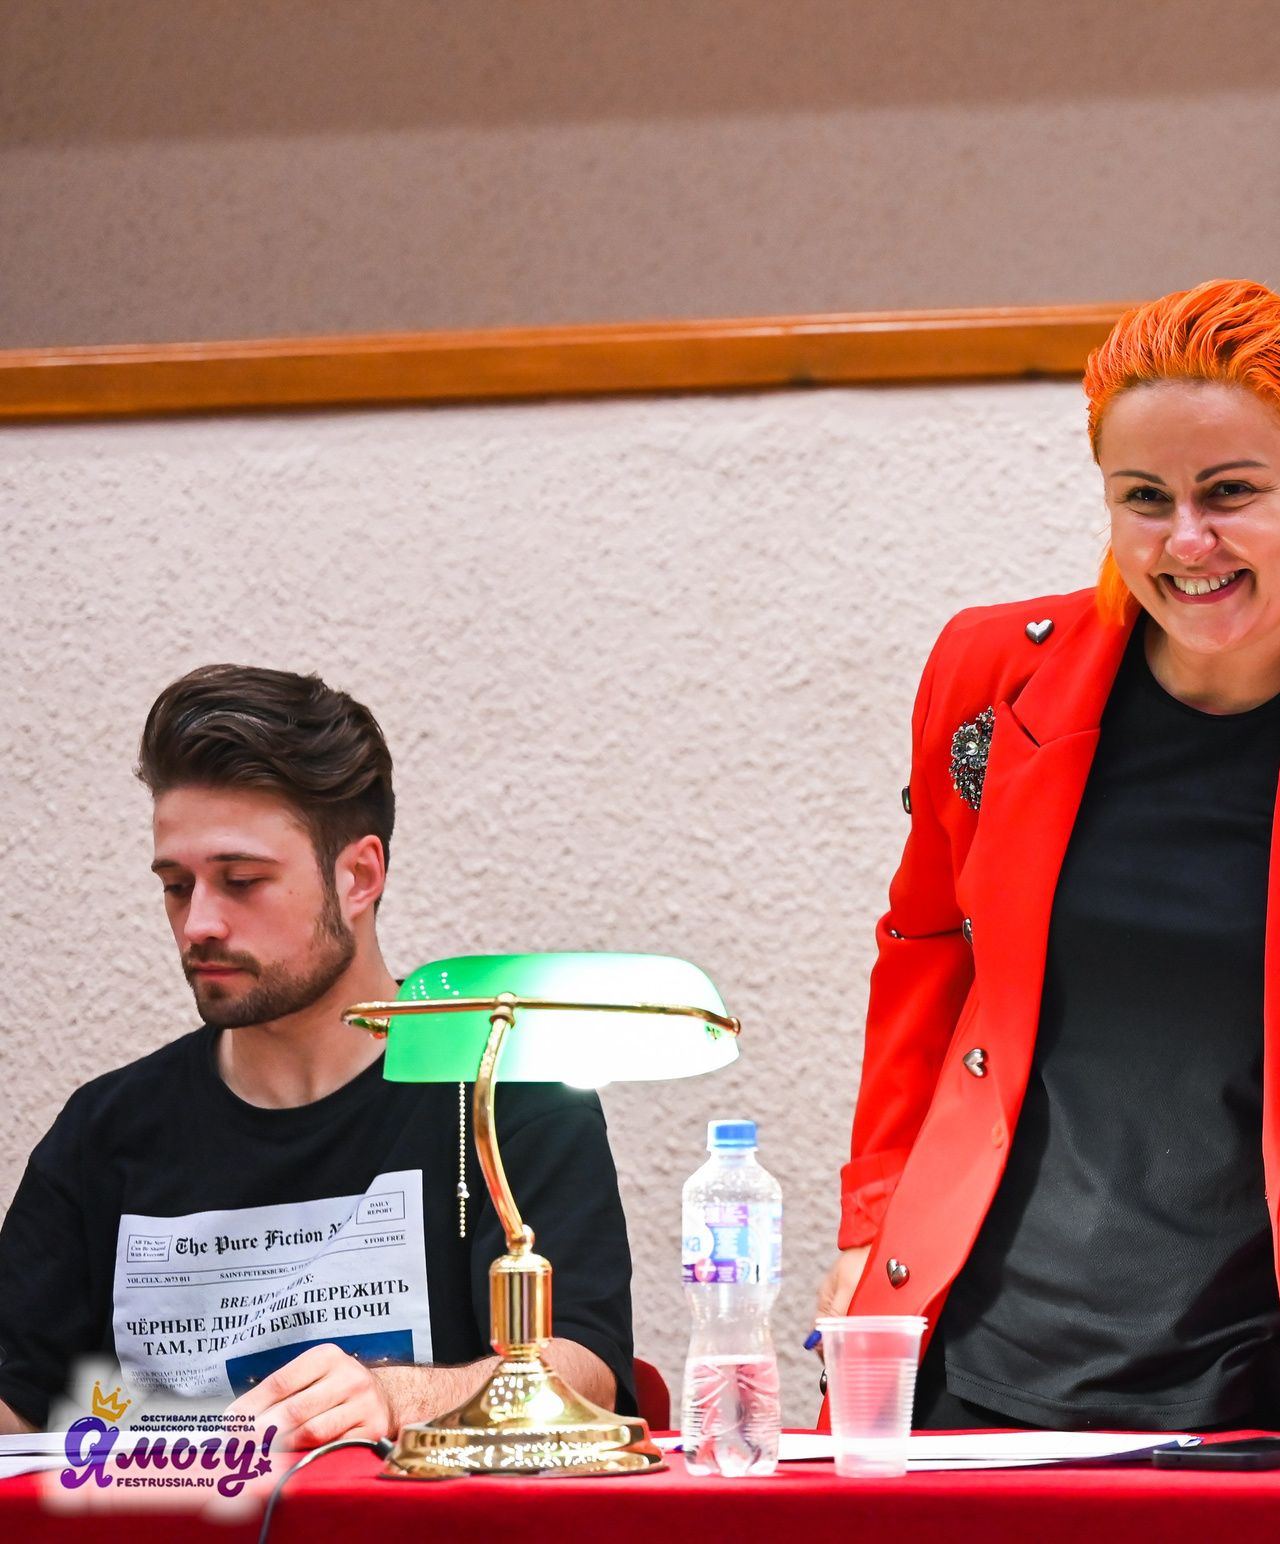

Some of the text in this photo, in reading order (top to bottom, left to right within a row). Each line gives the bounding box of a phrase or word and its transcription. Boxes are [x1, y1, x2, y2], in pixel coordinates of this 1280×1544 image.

[367, 1208, 393, 1216] REPORT
[370, 1200, 390, 1208] DAILY
[176, 1237, 208, 1257] The
[215, 1234, 258, 1255] Pure
[264, 1228, 323, 1251] Fiction
[386, 1233, 406, 1243] FREE
[126, 1318, 206, 1336] ЧЁРНЫЕ
[211, 1314, 249, 1333] ДНИ
[303, 1279, 410, 1304] ПЕРЕЖИТЬ
[143, 1302, 391, 1356] ТАМ, ГДЕ ЕСТЬ БЕЛЫЕ НОЧИ
